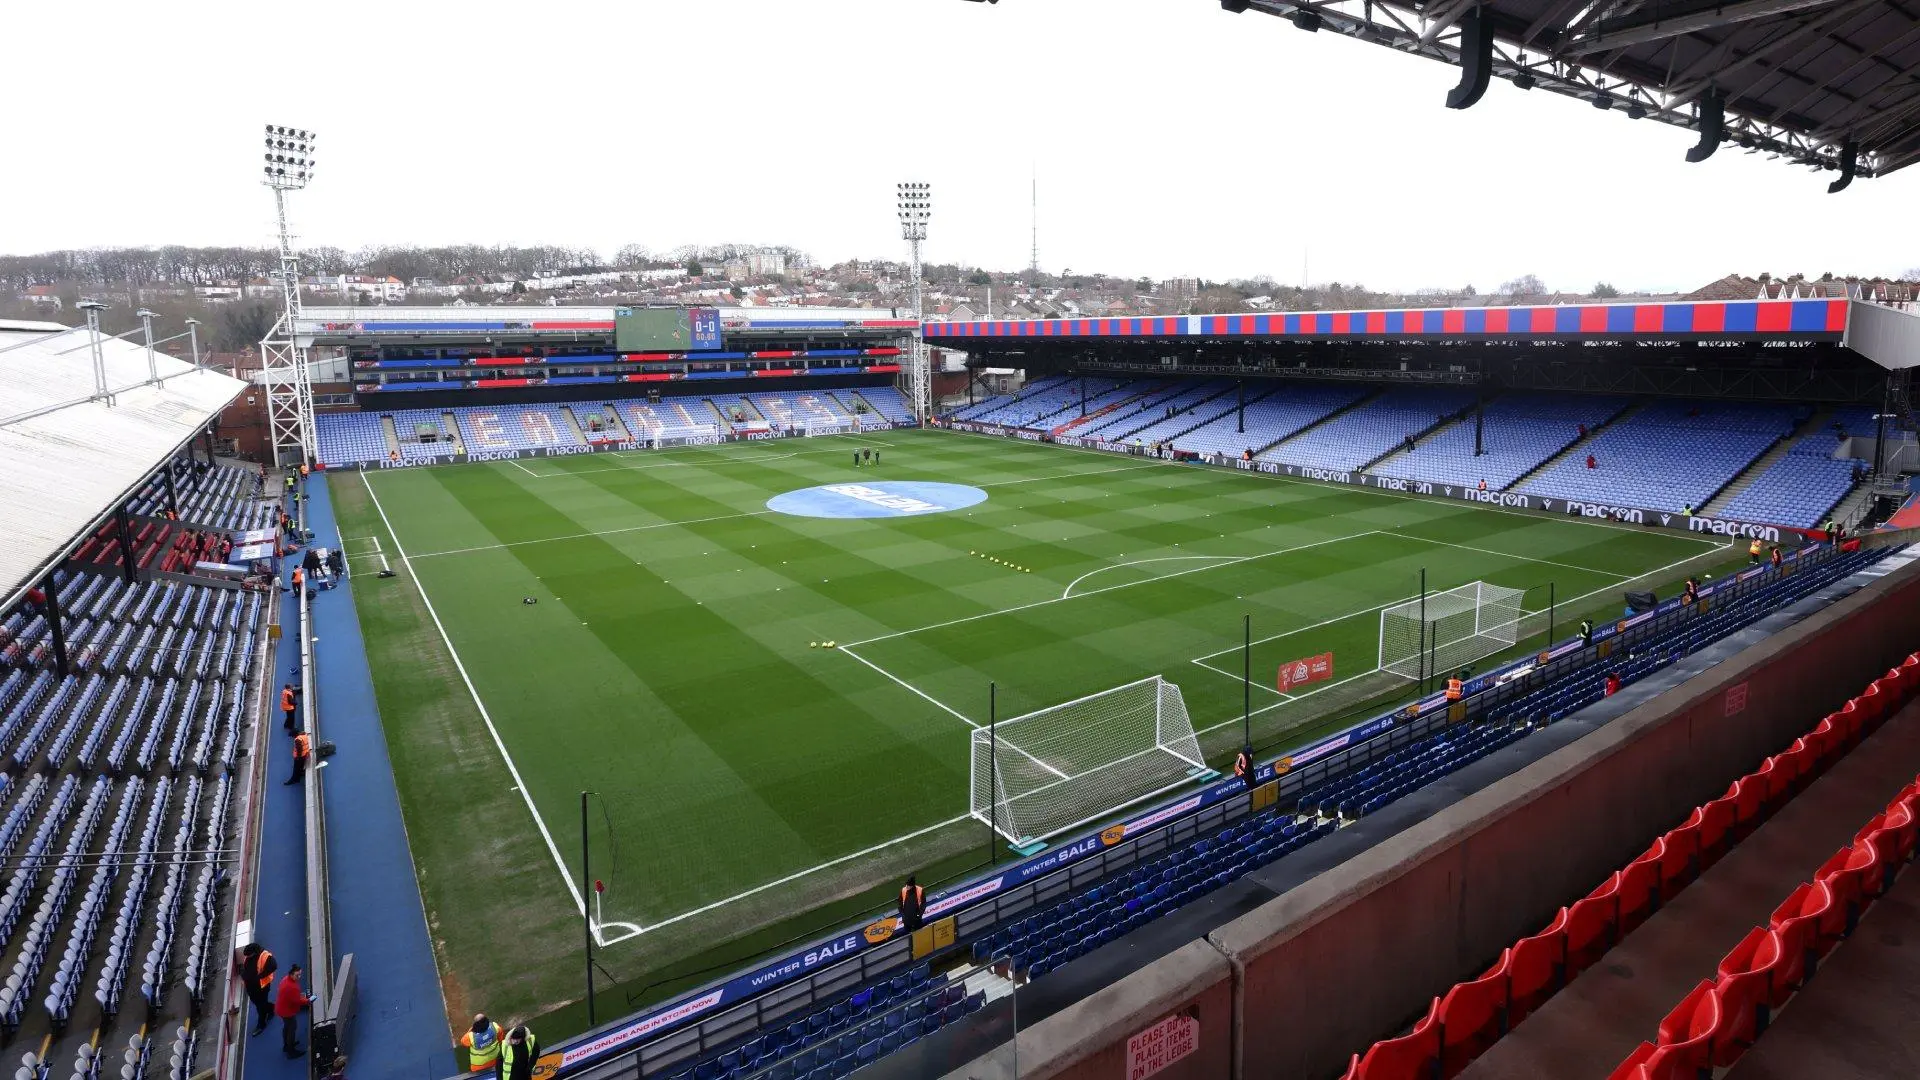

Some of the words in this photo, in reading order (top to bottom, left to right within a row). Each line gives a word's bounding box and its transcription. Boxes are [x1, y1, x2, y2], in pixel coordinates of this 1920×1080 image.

[696, 321, 715, 332] 0-0
[747, 429, 786, 440] macron
[468, 450, 520, 462] macron
[546, 443, 594, 455] macron
[1096, 440, 1127, 454] macron
[380, 454, 437, 469] macron
[1302, 466, 1350, 484] macron
[1464, 487, 1529, 508] macron
[1566, 499, 1643, 524] macron
[1689, 516, 1779, 543] macron
[1022, 857, 1056, 876] WINTER
[1058, 838, 1096, 862] SALE
[752, 961, 800, 986] WINTER
[804, 936, 857, 967] SALE
[940, 900, 954, 909] AND
[981, 882, 997, 892] NOW
[565, 1048, 593, 1062] SHOP
[594, 1032, 629, 1050] ONLINE
[629, 1023, 650, 1036] AND
[651, 1019, 661, 1028] IN
[661, 1008, 690, 1023] STORE
[691, 998, 713, 1010] NOW
[1131, 1025, 1164, 1053] PLEASE
[1167, 1020, 1178, 1034] DO
[1135, 1040, 1163, 1065] PLACE
[1166, 1025, 1191, 1048] ITEMS
[1132, 1065, 1145, 1080] ON
[1148, 1054, 1164, 1072] THE
[1166, 1038, 1193, 1062] LEDGE
